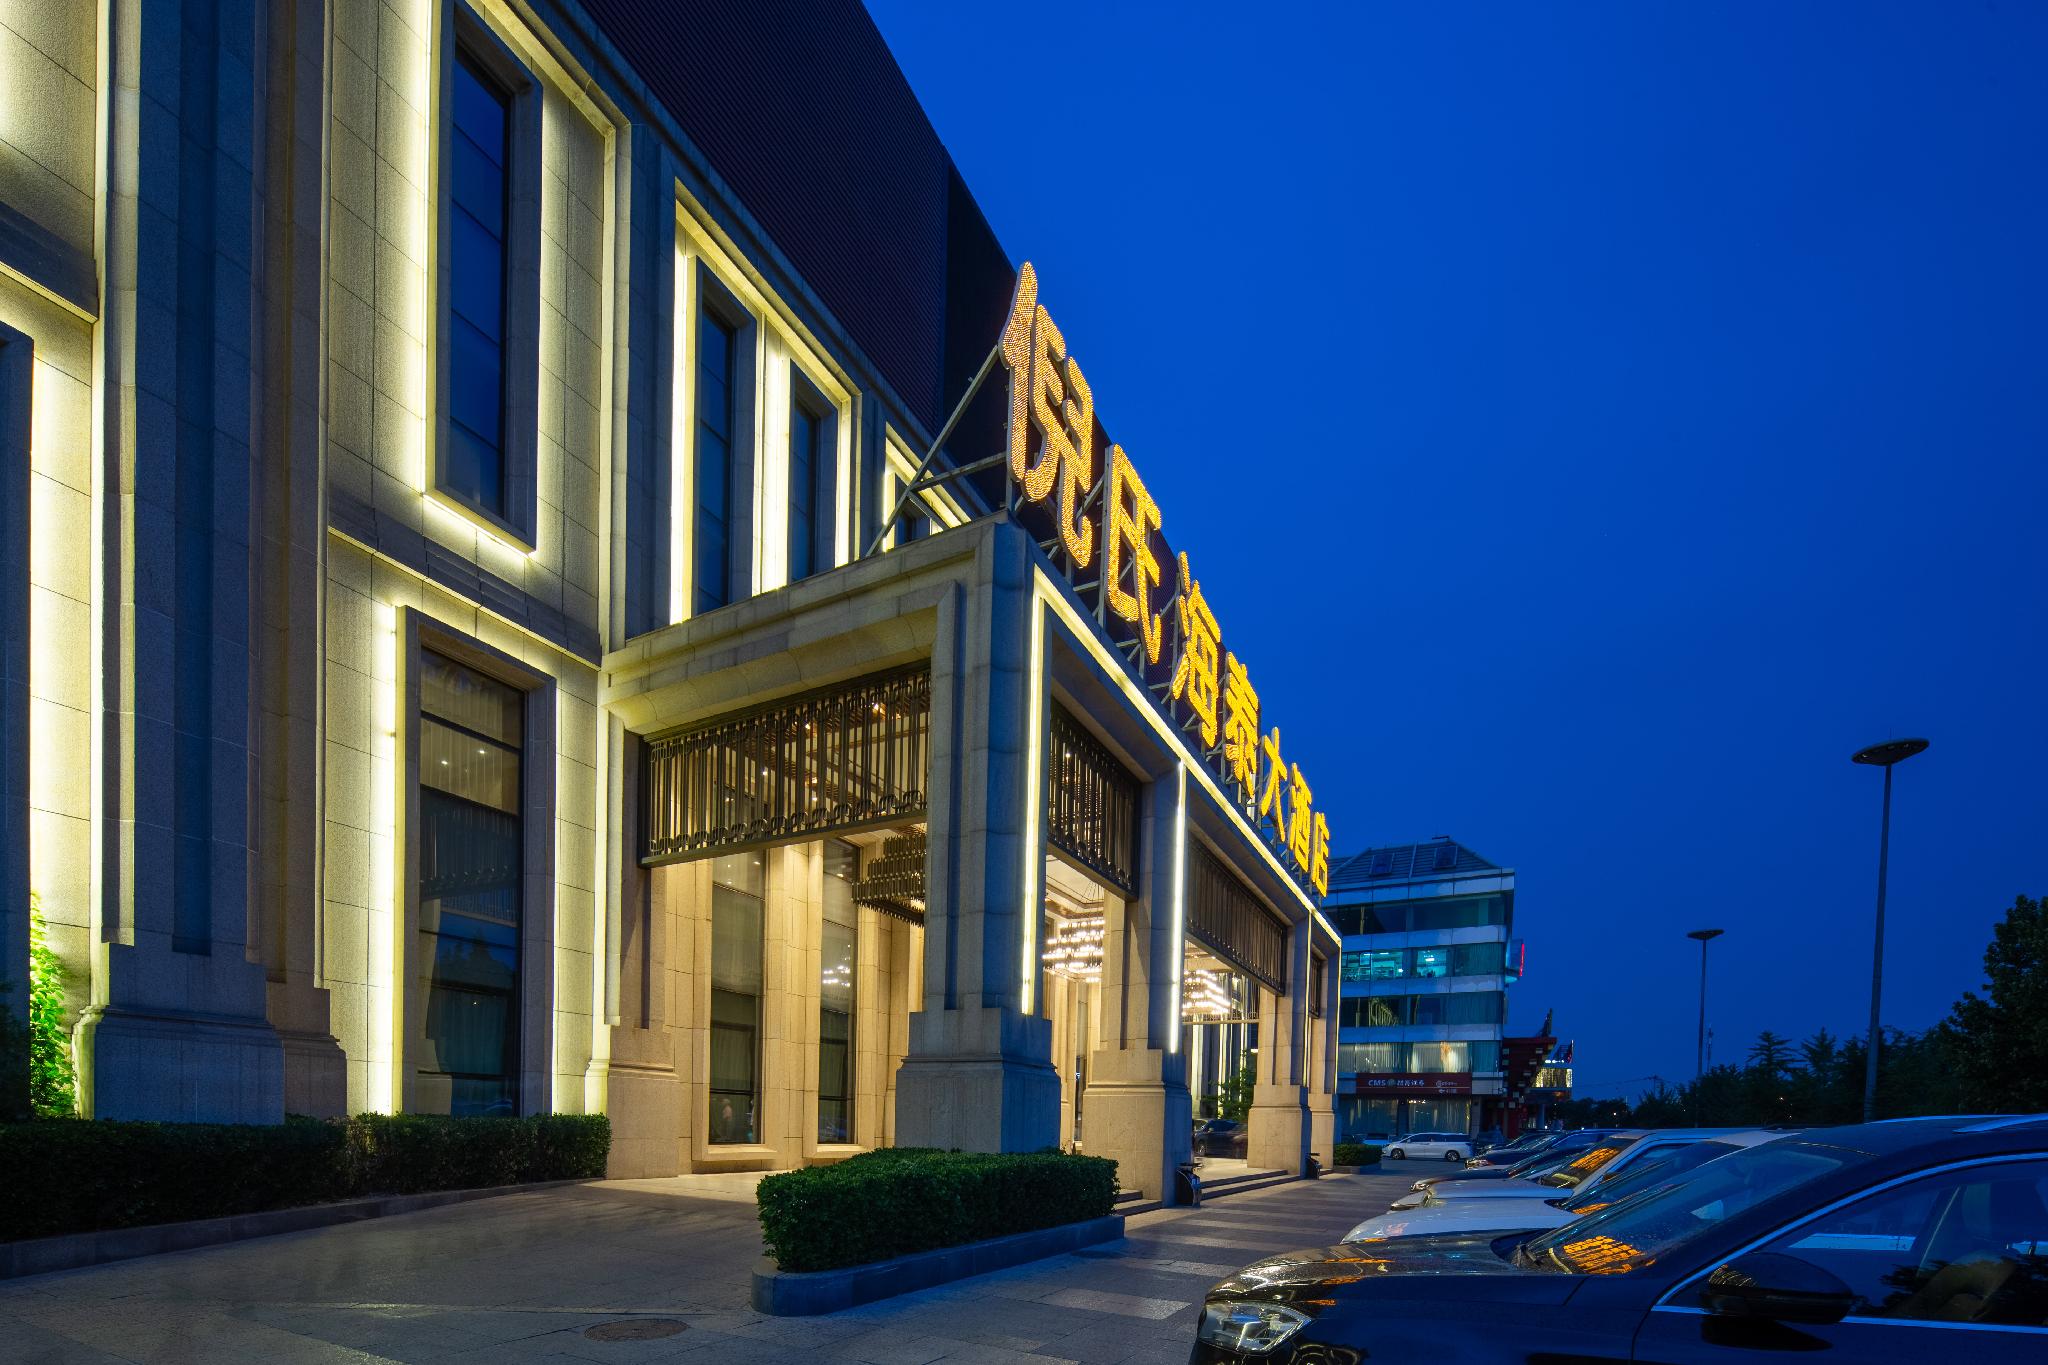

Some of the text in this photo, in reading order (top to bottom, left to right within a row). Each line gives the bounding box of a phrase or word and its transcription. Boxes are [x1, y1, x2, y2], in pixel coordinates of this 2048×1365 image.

[999, 261, 1330, 897] 倪氏海泰大酒店
[1368, 1079, 1386, 1087] CMS
